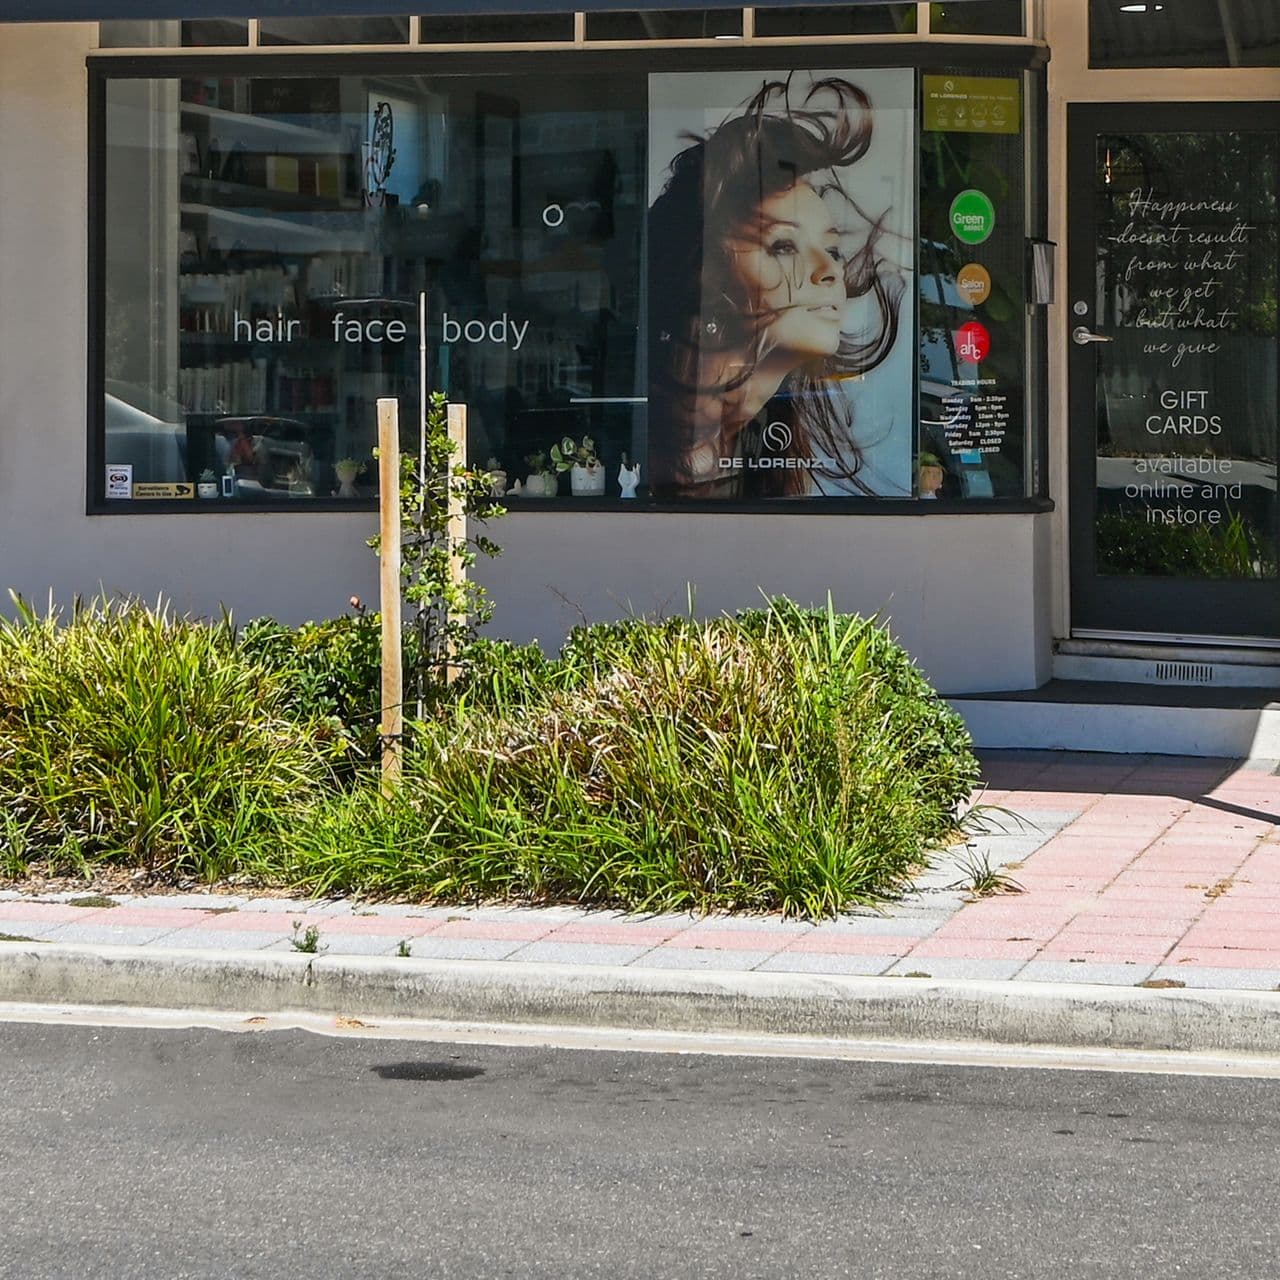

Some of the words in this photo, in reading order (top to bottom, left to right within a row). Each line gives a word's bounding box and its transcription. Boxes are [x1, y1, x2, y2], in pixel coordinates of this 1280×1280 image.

[1129, 187, 1239, 220] Happiness
[953, 213, 984, 224] Green
[1189, 223, 1256, 243] result
[1125, 256, 1177, 281] from
[1184, 250, 1244, 270] what
[961, 279, 984, 289] Salon
[1149, 285, 1178, 298] we
[1179, 278, 1222, 312] get
[1135, 308, 1180, 329] but
[1177, 308, 1238, 329] what
[233, 310, 300, 342] hair
[332, 312, 407, 342] face
[442, 313, 529, 351] body
[1143, 342, 1171, 353] we
[1172, 342, 1220, 368] give
[1160, 390, 1208, 409] GIFT
[1145, 415, 1222, 434] CARDS
[719, 457, 743, 469] DE
[1135, 455, 1232, 474] available
[1125, 480, 1194, 498] online
[1201, 481, 1242, 499] and
[1146, 504, 1221, 524] instore
